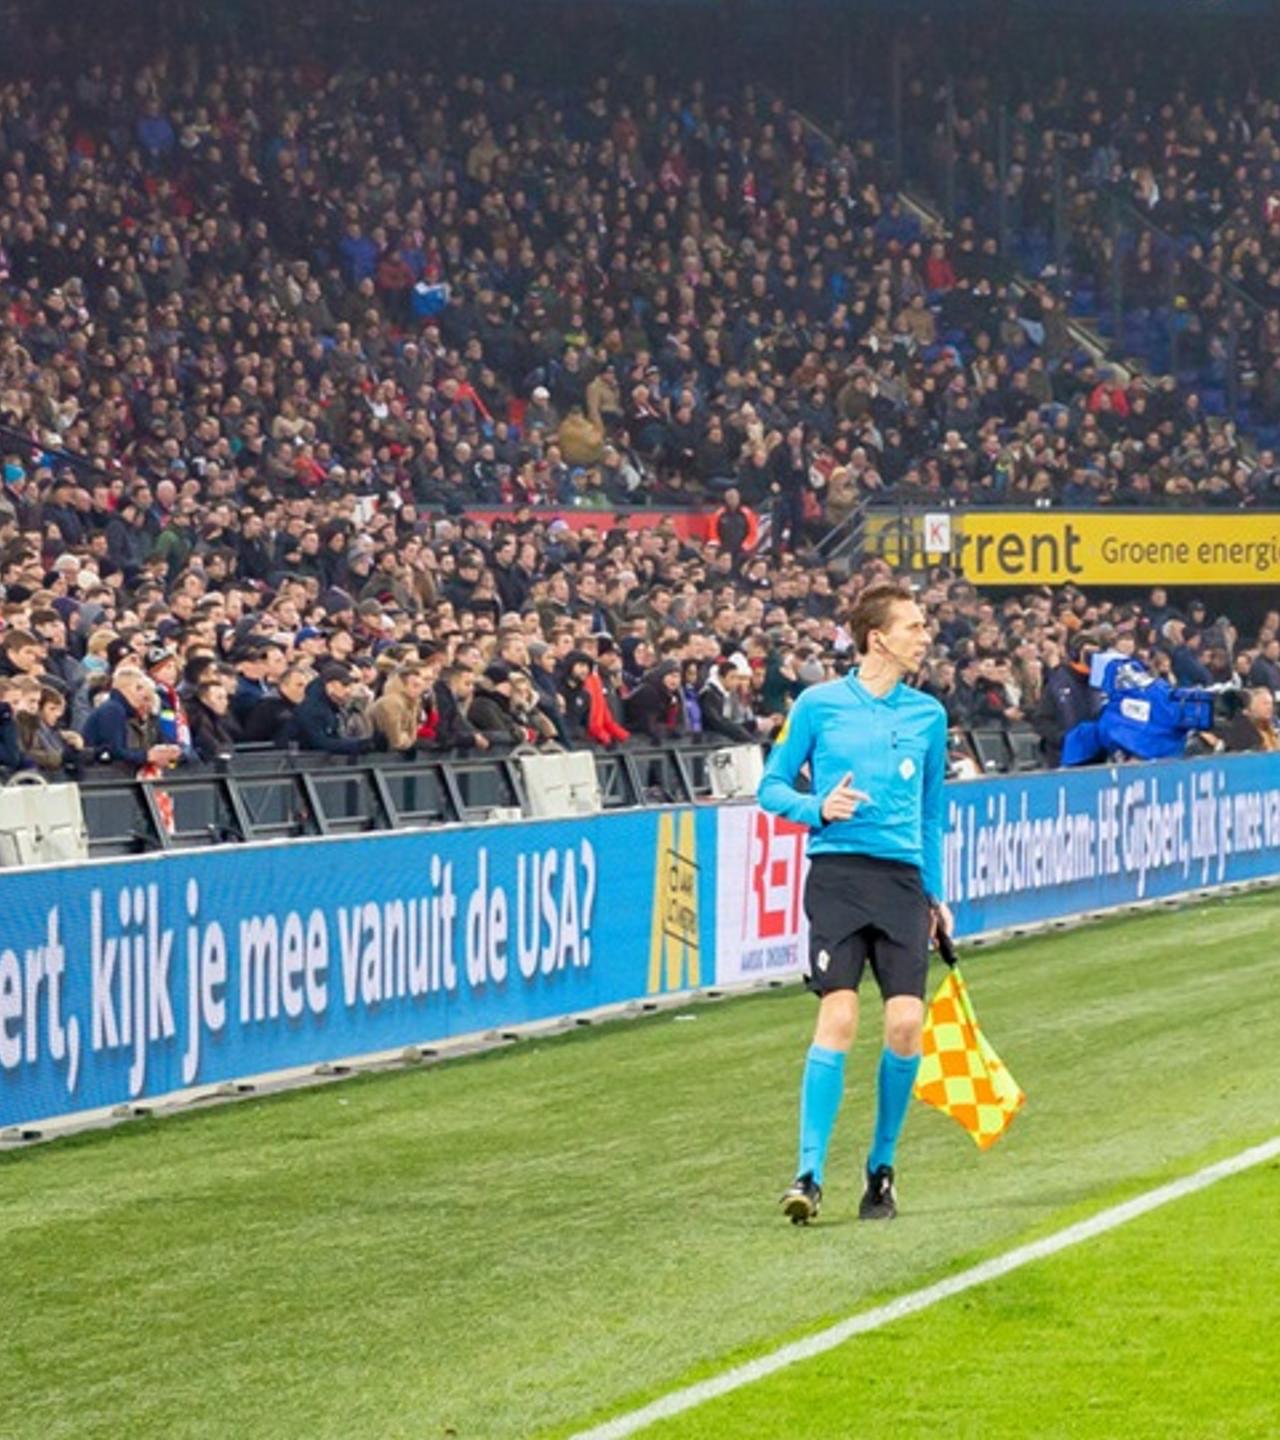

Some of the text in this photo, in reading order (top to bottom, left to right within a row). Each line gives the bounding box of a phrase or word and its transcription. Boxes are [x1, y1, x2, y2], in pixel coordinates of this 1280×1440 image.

[930, 521, 945, 544] K
[1102, 536, 1190, 565] Groene
[966, 787, 1096, 900] Leidschendam:
[89, 880, 176, 1099] kijk
[180, 877, 227, 1086] je
[239, 907, 328, 1024] mee
[337, 852, 458, 1008] vanuit
[465, 857, 510, 986] de
[516, 838, 597, 980] USA?
